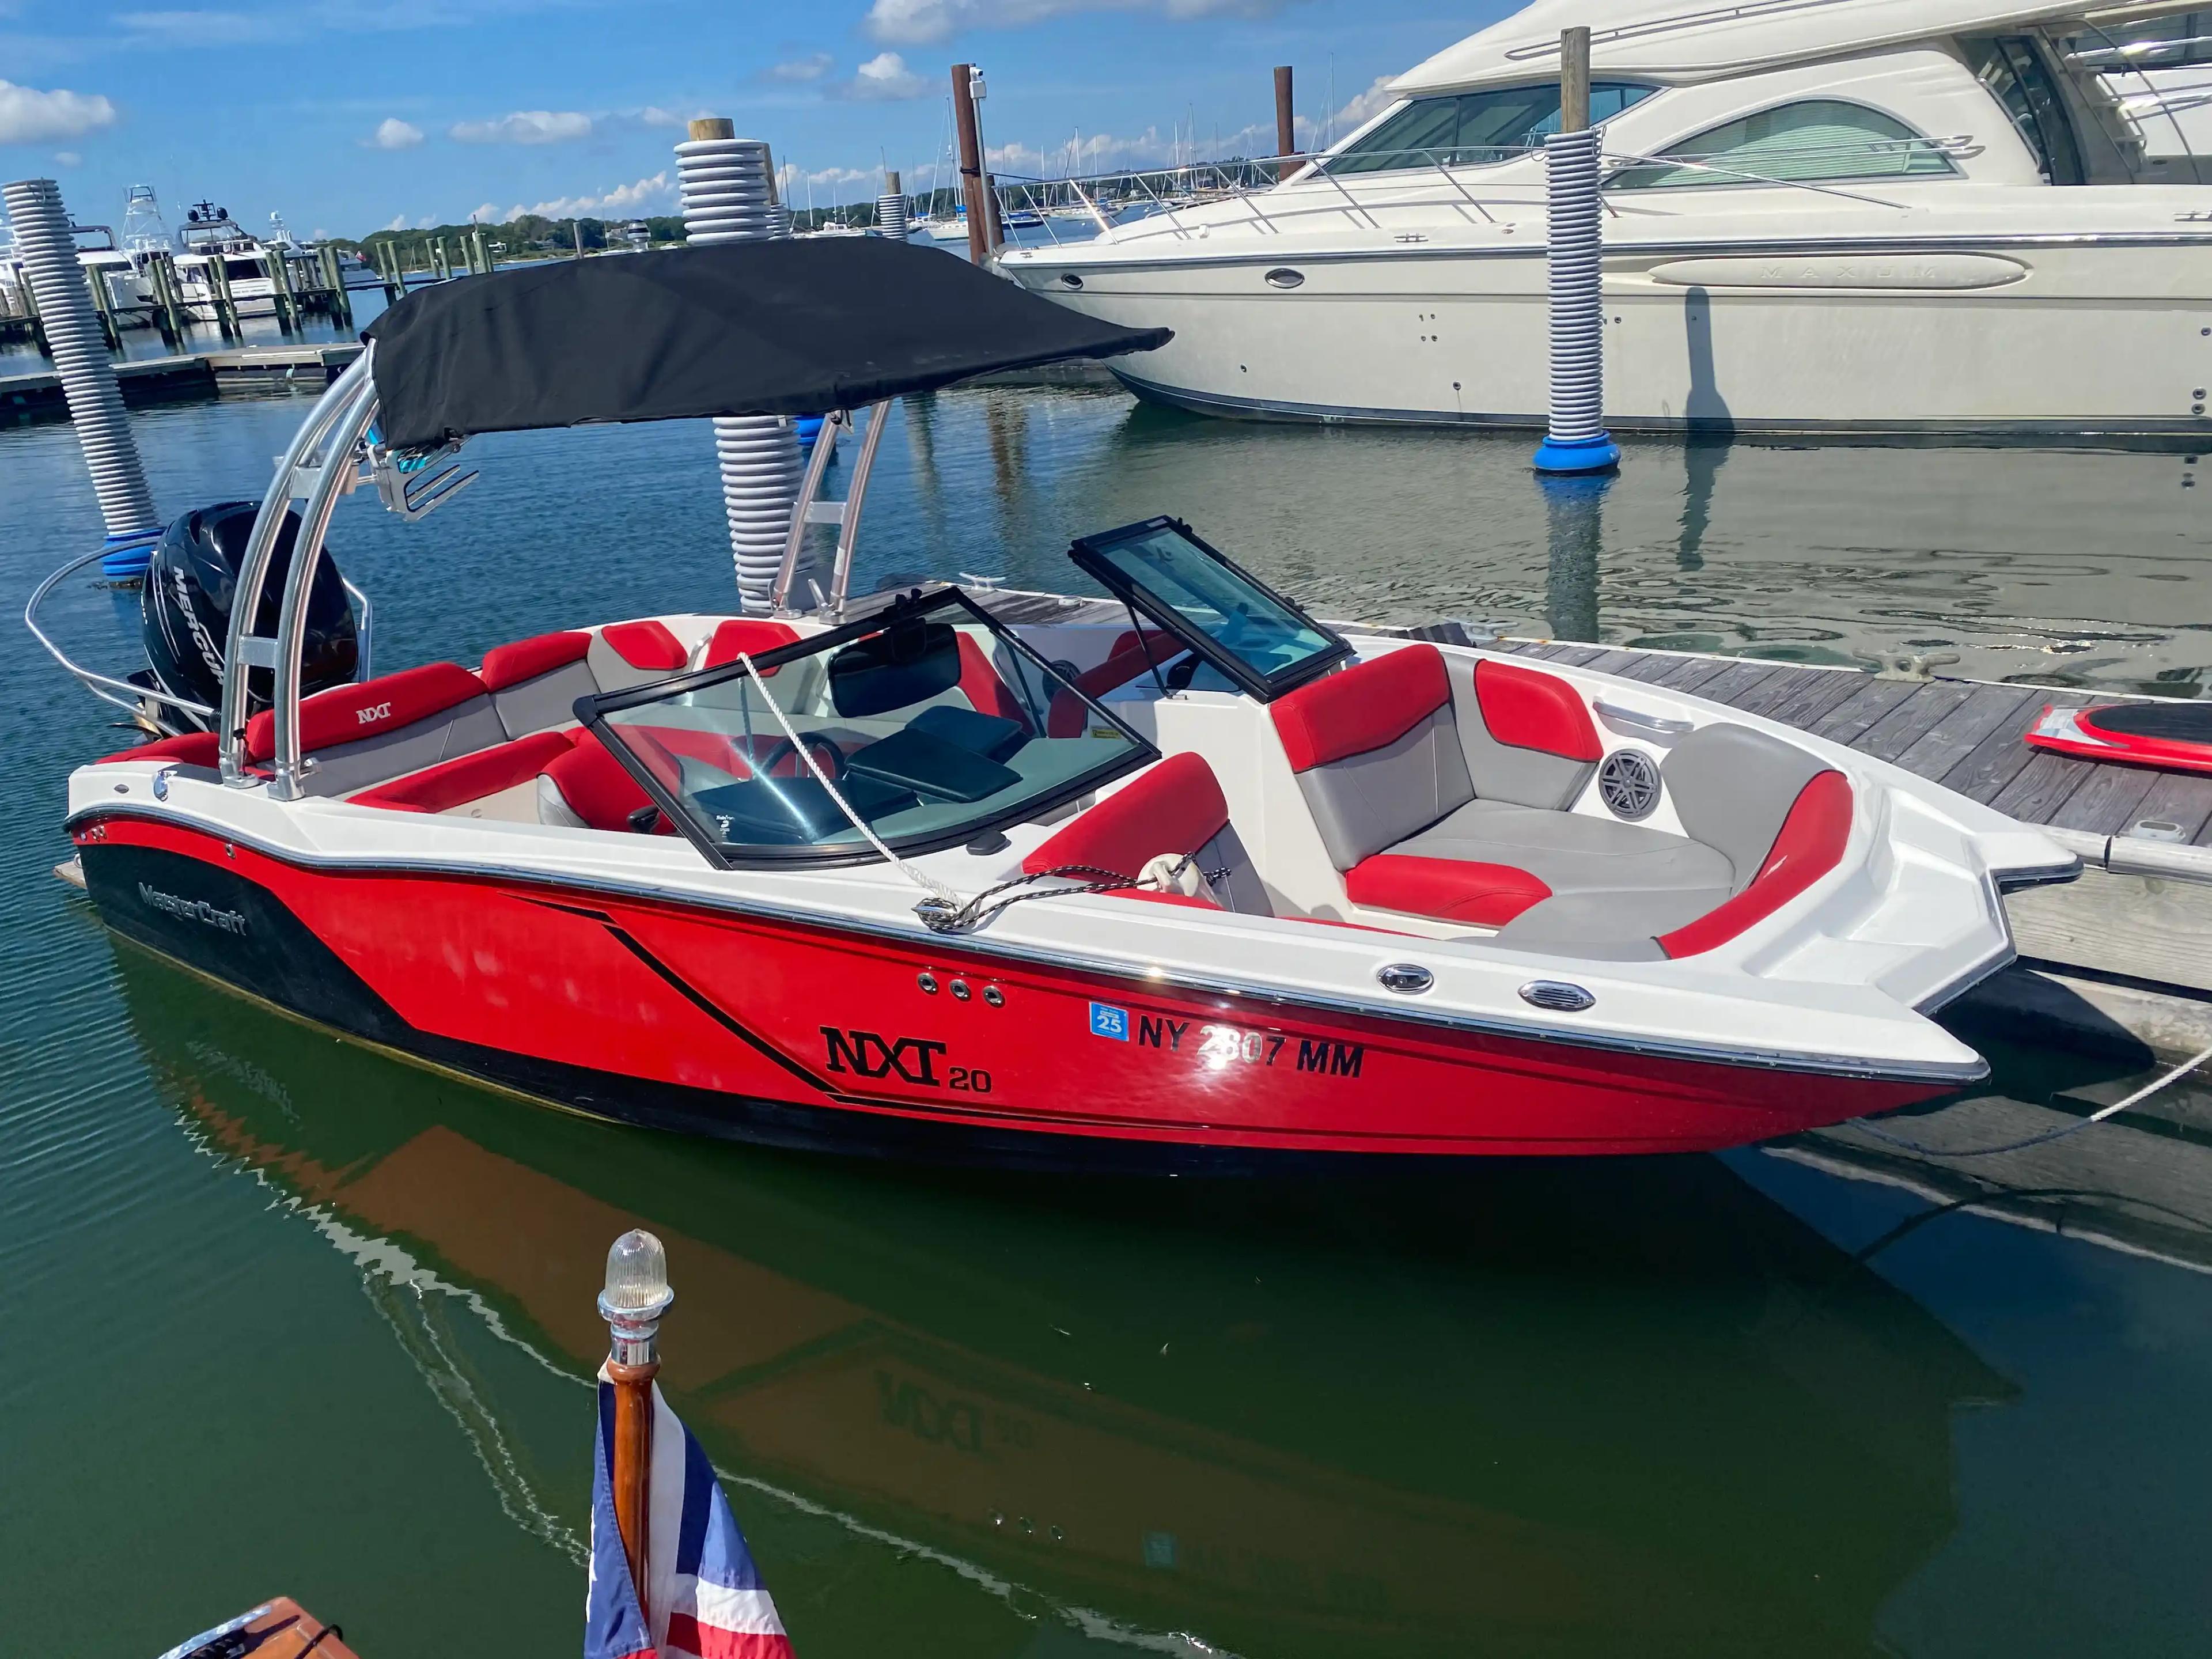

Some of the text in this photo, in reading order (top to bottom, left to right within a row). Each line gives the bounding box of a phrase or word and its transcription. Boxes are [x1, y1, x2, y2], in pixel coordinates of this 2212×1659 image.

[1760, 266, 1937, 279] MAXUM
[173, 565, 225, 685] MERCUR
[356, 702, 391, 724] NXT
[138, 882, 247, 936] MasterCraft
[1097, 1015, 1122, 1033] 25
[1138, 1014, 1190, 1051] NY
[1297, 1040, 1365, 1078] MM
[819, 1025, 992, 1093] NXT 20
